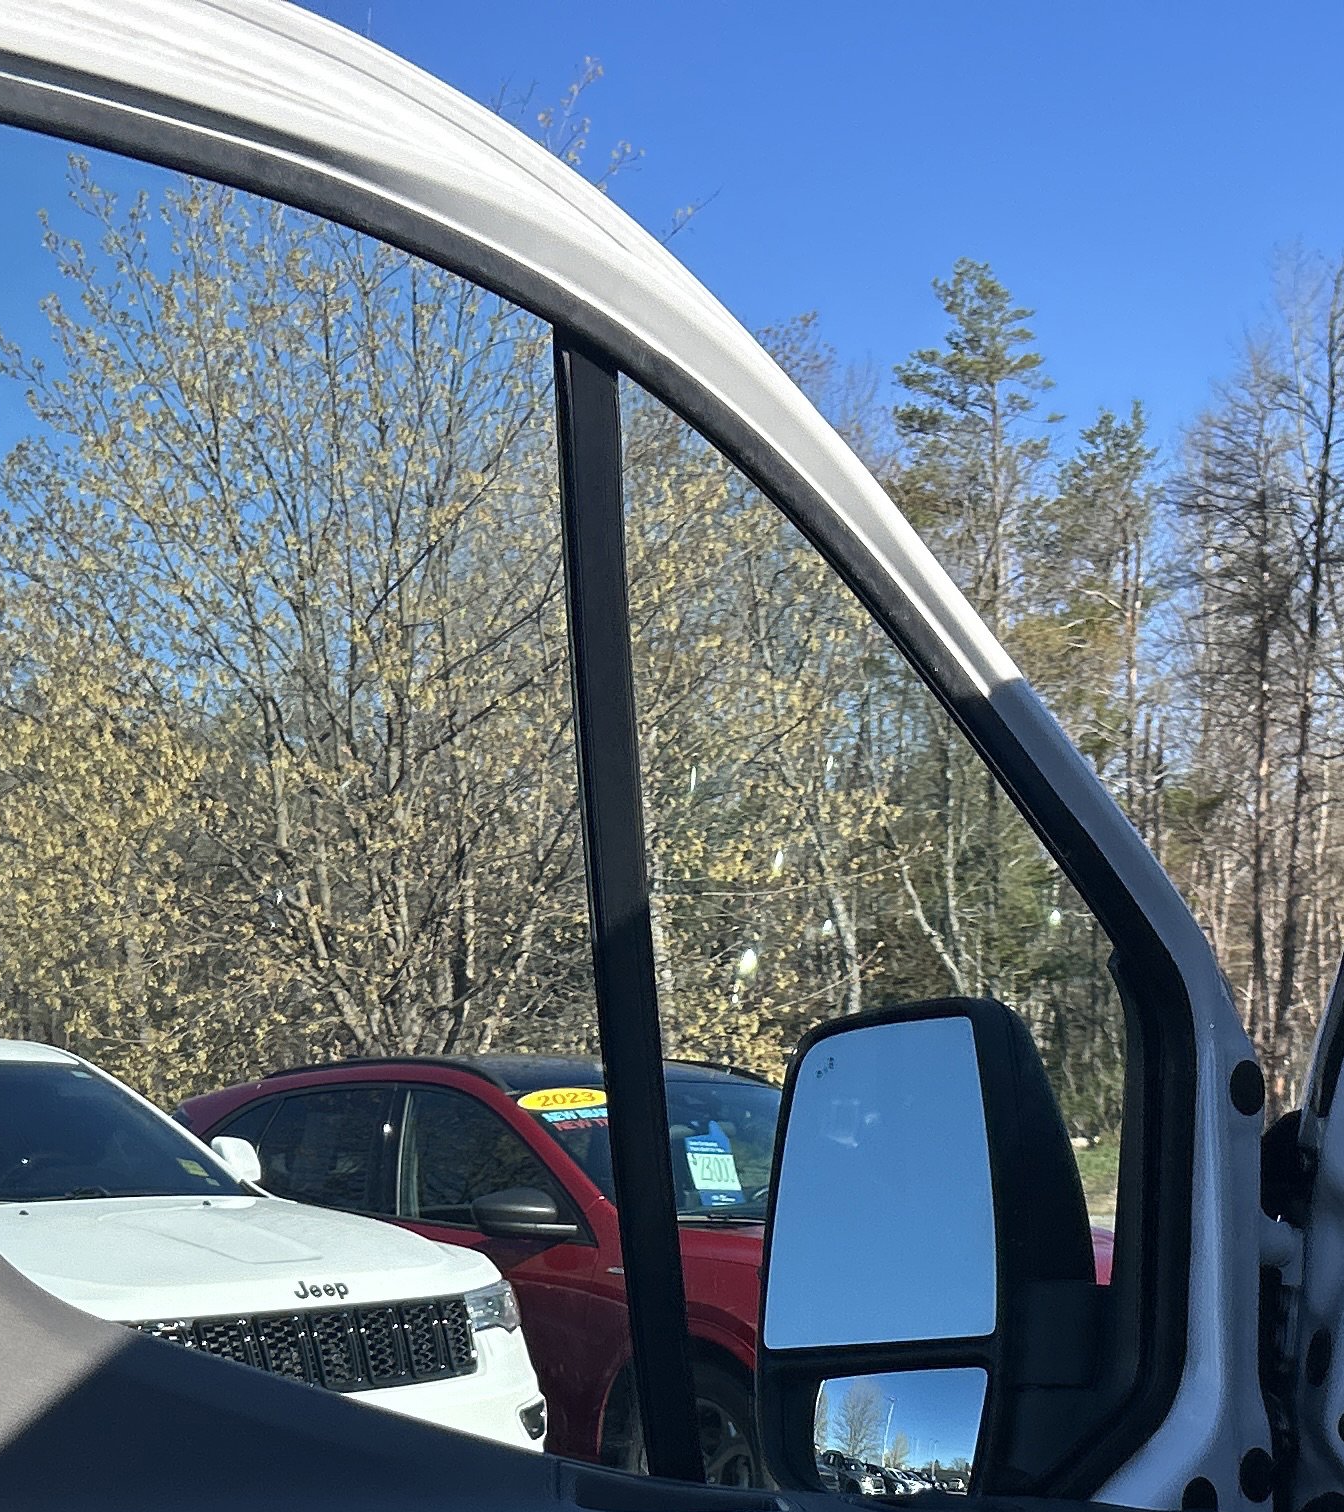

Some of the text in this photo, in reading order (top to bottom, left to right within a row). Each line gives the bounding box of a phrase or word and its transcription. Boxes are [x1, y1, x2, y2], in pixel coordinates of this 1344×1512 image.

[538, 1092, 596, 1107] 2023
[541, 1110, 578, 1122] NEW
[552, 1119, 593, 1131] NEW
[293, 1280, 350, 1300] Jeep
